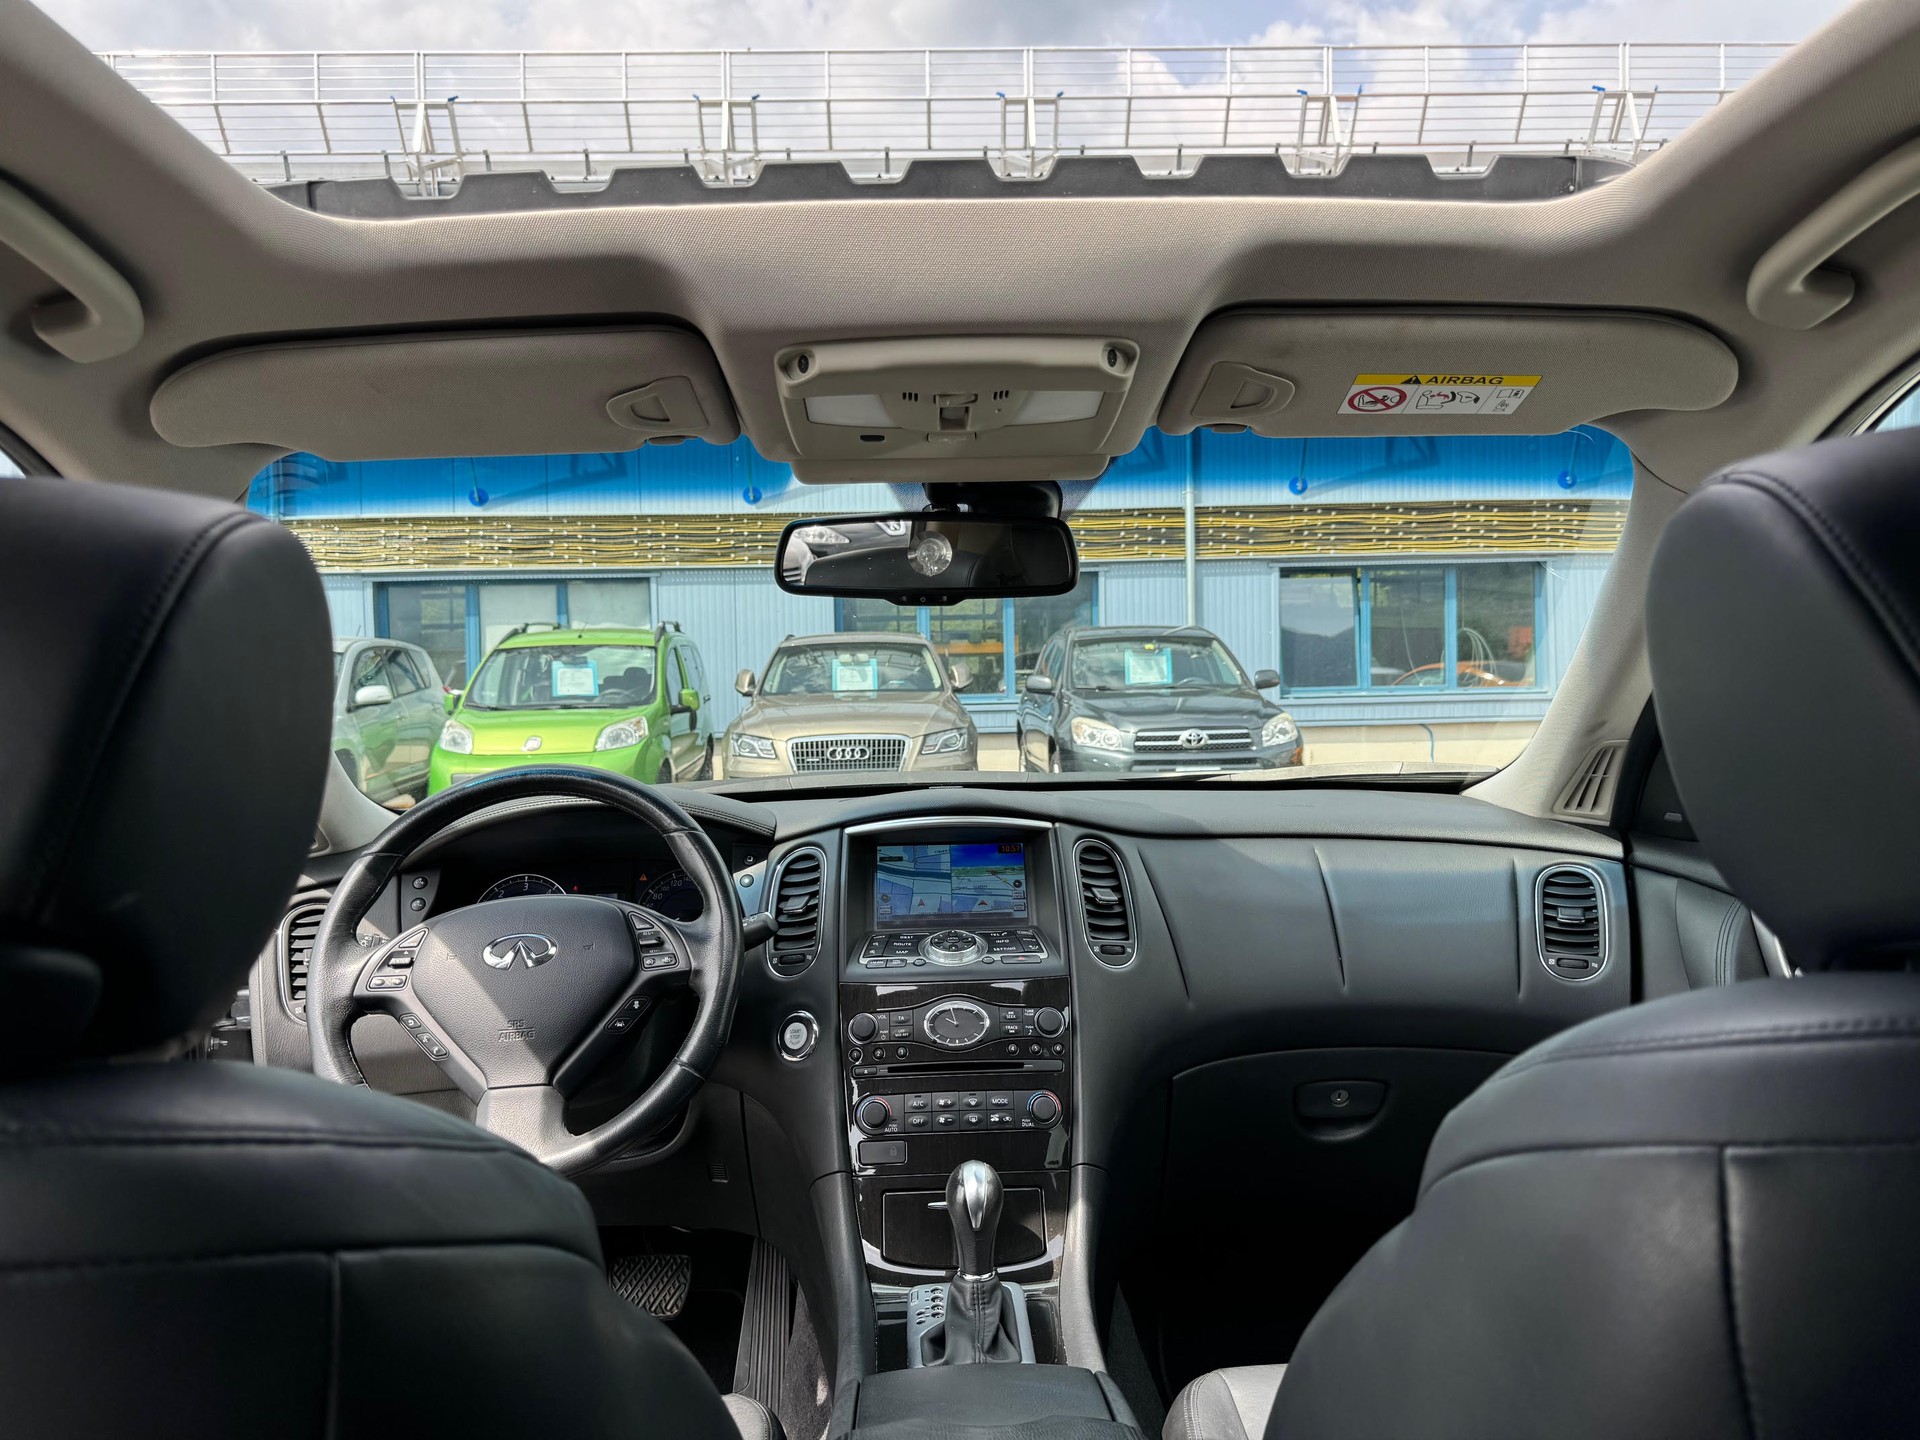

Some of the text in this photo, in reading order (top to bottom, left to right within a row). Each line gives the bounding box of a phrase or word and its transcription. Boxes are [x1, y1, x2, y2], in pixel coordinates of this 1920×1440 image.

[1425, 376, 1504, 385] AIRBAG
[1001, 845, 1020, 853] 10:57
[523, 882, 529, 891] 3
[498, 890, 505, 898] 2
[507, 1020, 525, 1030] SRS
[498, 1030, 536, 1042] AIRBAG
